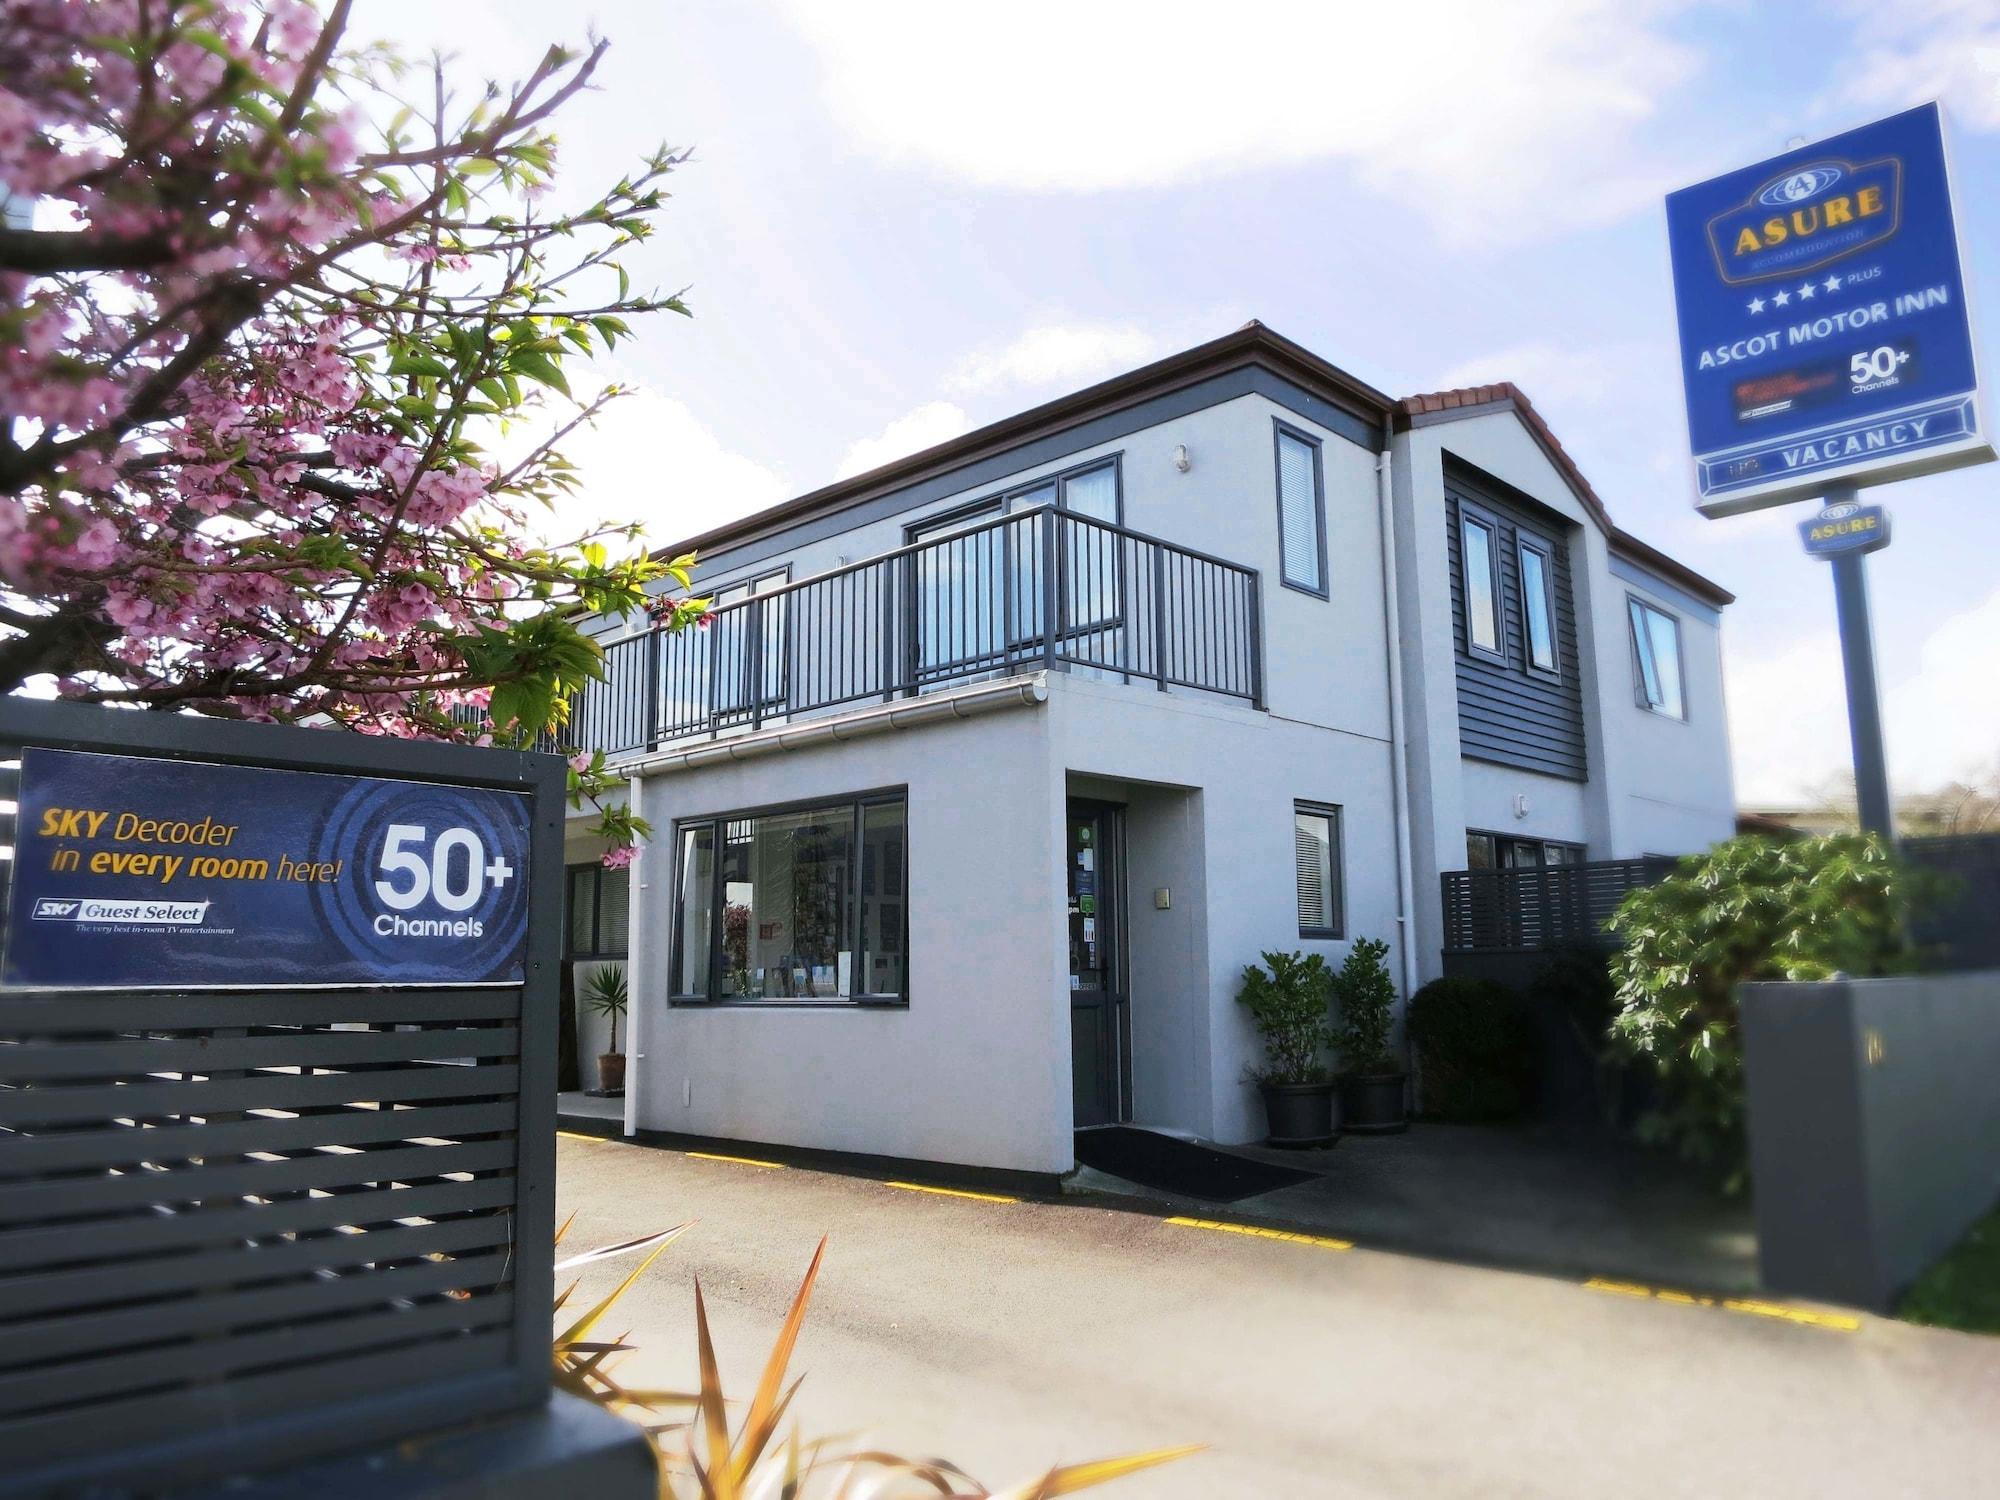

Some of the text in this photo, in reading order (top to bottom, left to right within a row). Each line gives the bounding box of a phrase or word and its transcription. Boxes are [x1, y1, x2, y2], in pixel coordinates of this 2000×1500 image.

[1734, 185, 1884, 256] ASURE
[1848, 266, 1882, 285] PLUS
[1699, 284, 1949, 370] ASCOT MOTOR INN
[1850, 346, 1910, 384] 50+
[1851, 376, 1899, 394] Channels
[1782, 418, 1929, 467] VACANCY
[1810, 516, 1877, 540] ASURE
[38, 808, 239, 846] SKY Decoder
[51, 843, 343, 884] in every room here!
[375, 824, 513, 911] 50+
[38, 902, 200, 920] SKY Guest Select
[75, 924, 91, 932] The
[113, 925, 130, 933] best
[132, 926, 165, 934] in-room
[167, 926, 179, 934] TV
[180, 927, 235, 935] entertainment
[374, 914, 484, 938] Channels
